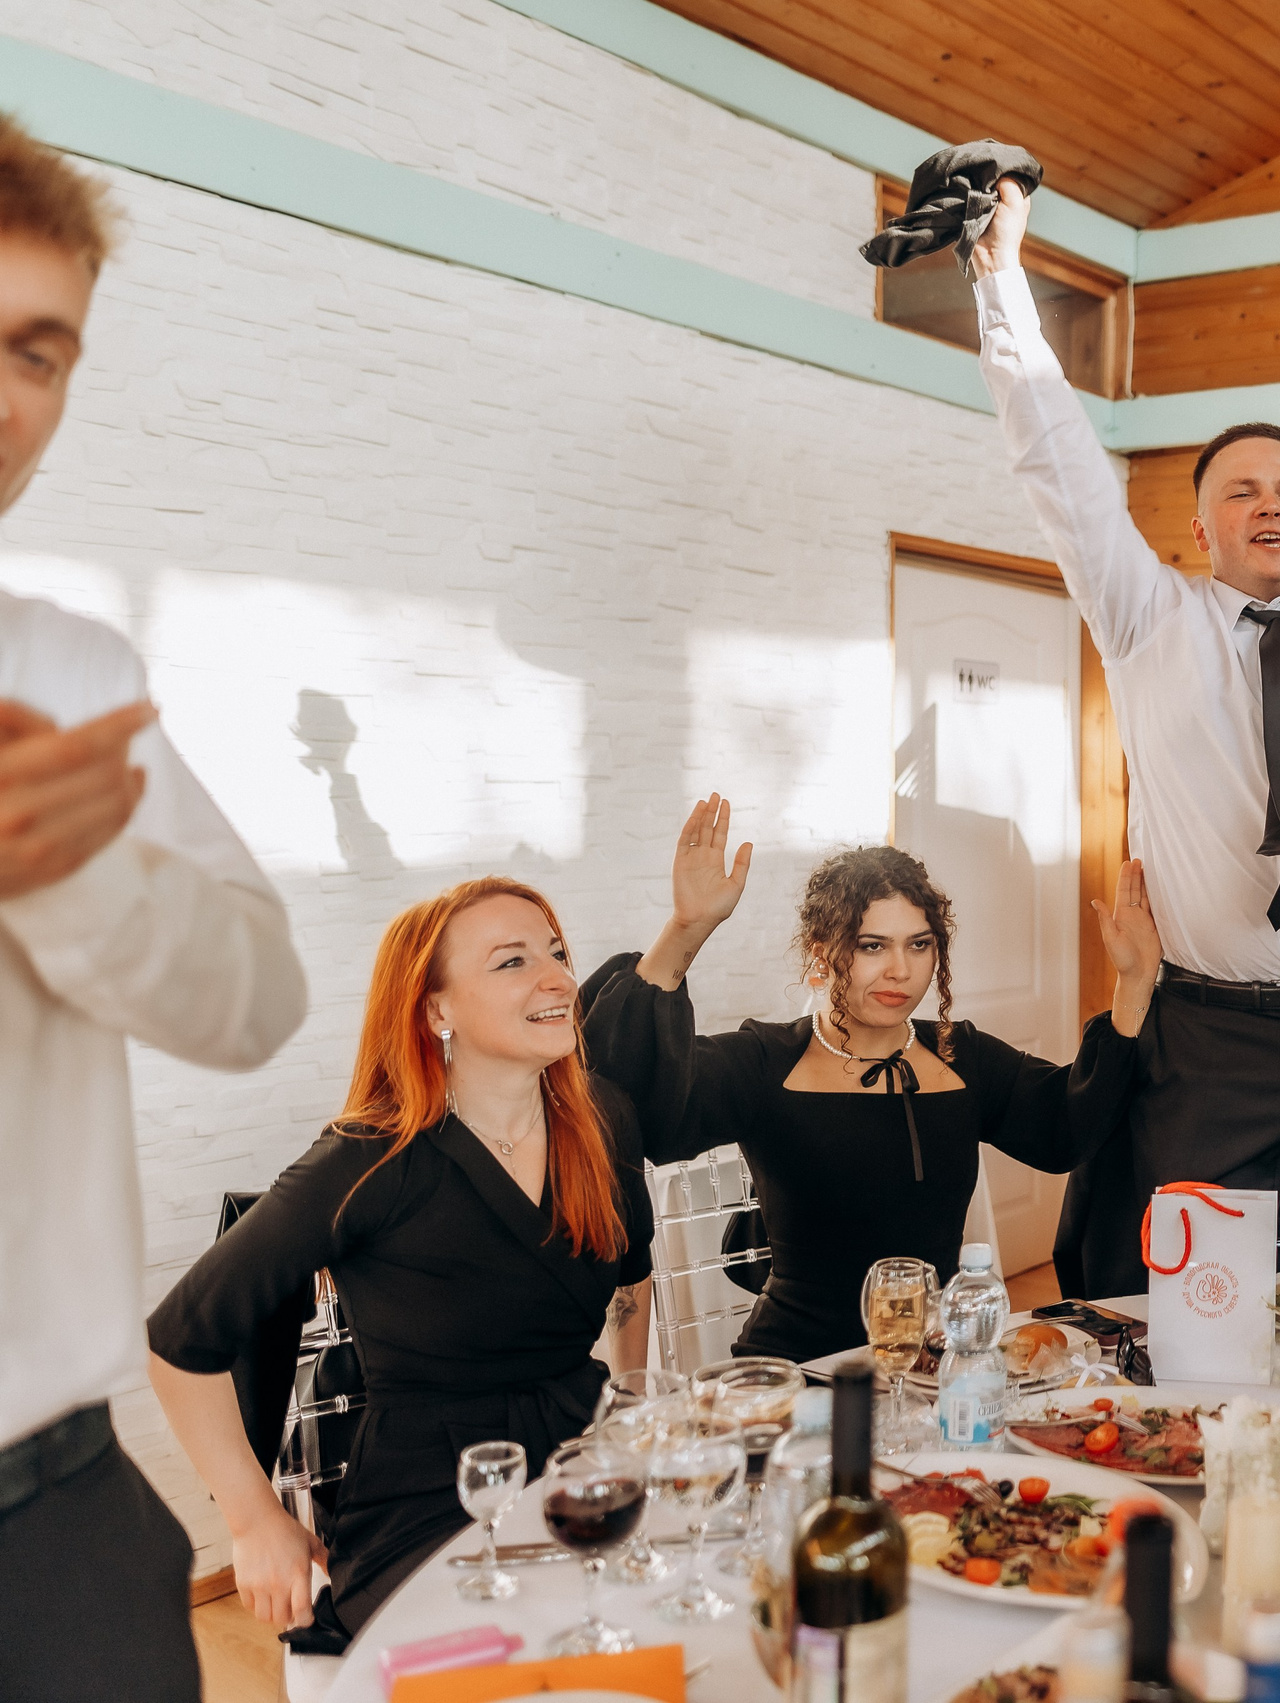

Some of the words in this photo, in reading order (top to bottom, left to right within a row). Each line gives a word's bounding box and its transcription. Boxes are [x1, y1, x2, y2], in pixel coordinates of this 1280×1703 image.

[976, 675, 996, 690] WC
[1184, 1261, 1219, 1285] ВОЛОГОДСКАЯ
[1221, 1265, 1239, 1288] ОБЛАСТЬ
[1183, 1292, 1195, 1308] ДУША
[1193, 1306, 1222, 1318] РУССКОГО
[1223, 1294, 1239, 1313] СЕВЕРА
